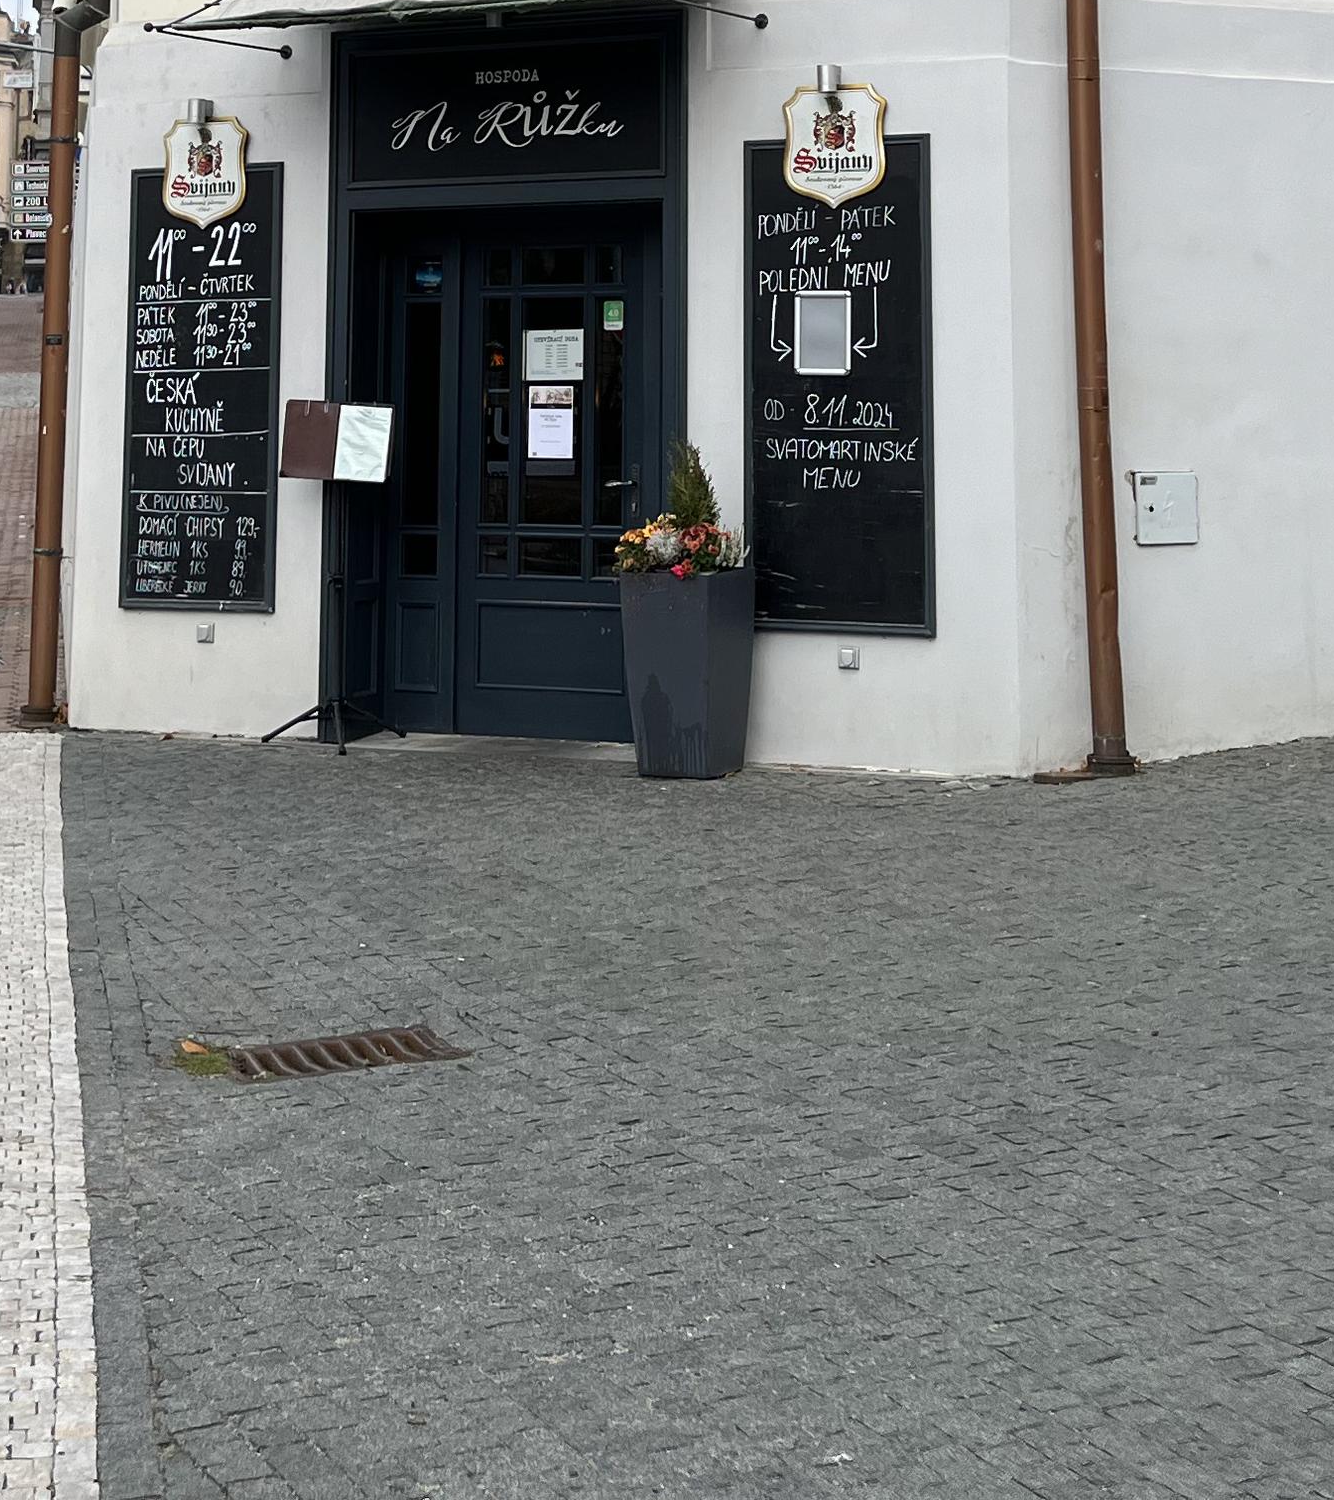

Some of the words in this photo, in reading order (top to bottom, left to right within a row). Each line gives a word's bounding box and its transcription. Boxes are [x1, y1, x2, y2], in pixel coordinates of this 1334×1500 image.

[475, 69, 540, 85] HOSPODA
[391, 101, 462, 151] Na
[793, 148, 872, 174] Svijany
[171, 174, 235, 198] Svijany
[758, 204, 819, 240] PONDĚLÍ
[841, 205, 896, 231] PÁTEK
[139, 277, 185, 300] PONDĚLÍ
[200, 273, 254, 295] ČTVRTEK
[759, 257, 833, 296] POLEDNÍ
[843, 259, 891, 288] MENU
[137, 306, 175, 326] PÁTEK
[136, 328, 175, 345] SOBOTA
[135, 345, 176, 369] NEDĚLE
[146, 372, 200, 404] ČESKÁ
[165, 401, 224, 432] KUCHYNĚ
[764, 398, 784, 420] OD
[145, 438, 166, 458] NA
[173, 436, 205, 458] ČEPU
[177, 462, 235, 487] SVIJANY
[803, 467, 861, 489] MENU
[139, 494, 148, 510] K
[139, 513, 179, 536] DOMÁCÍ
[186, 515, 225, 538] CHIPSY
[190, 540, 209, 559] 1KS
[190, 561, 206, 575] 1KS
